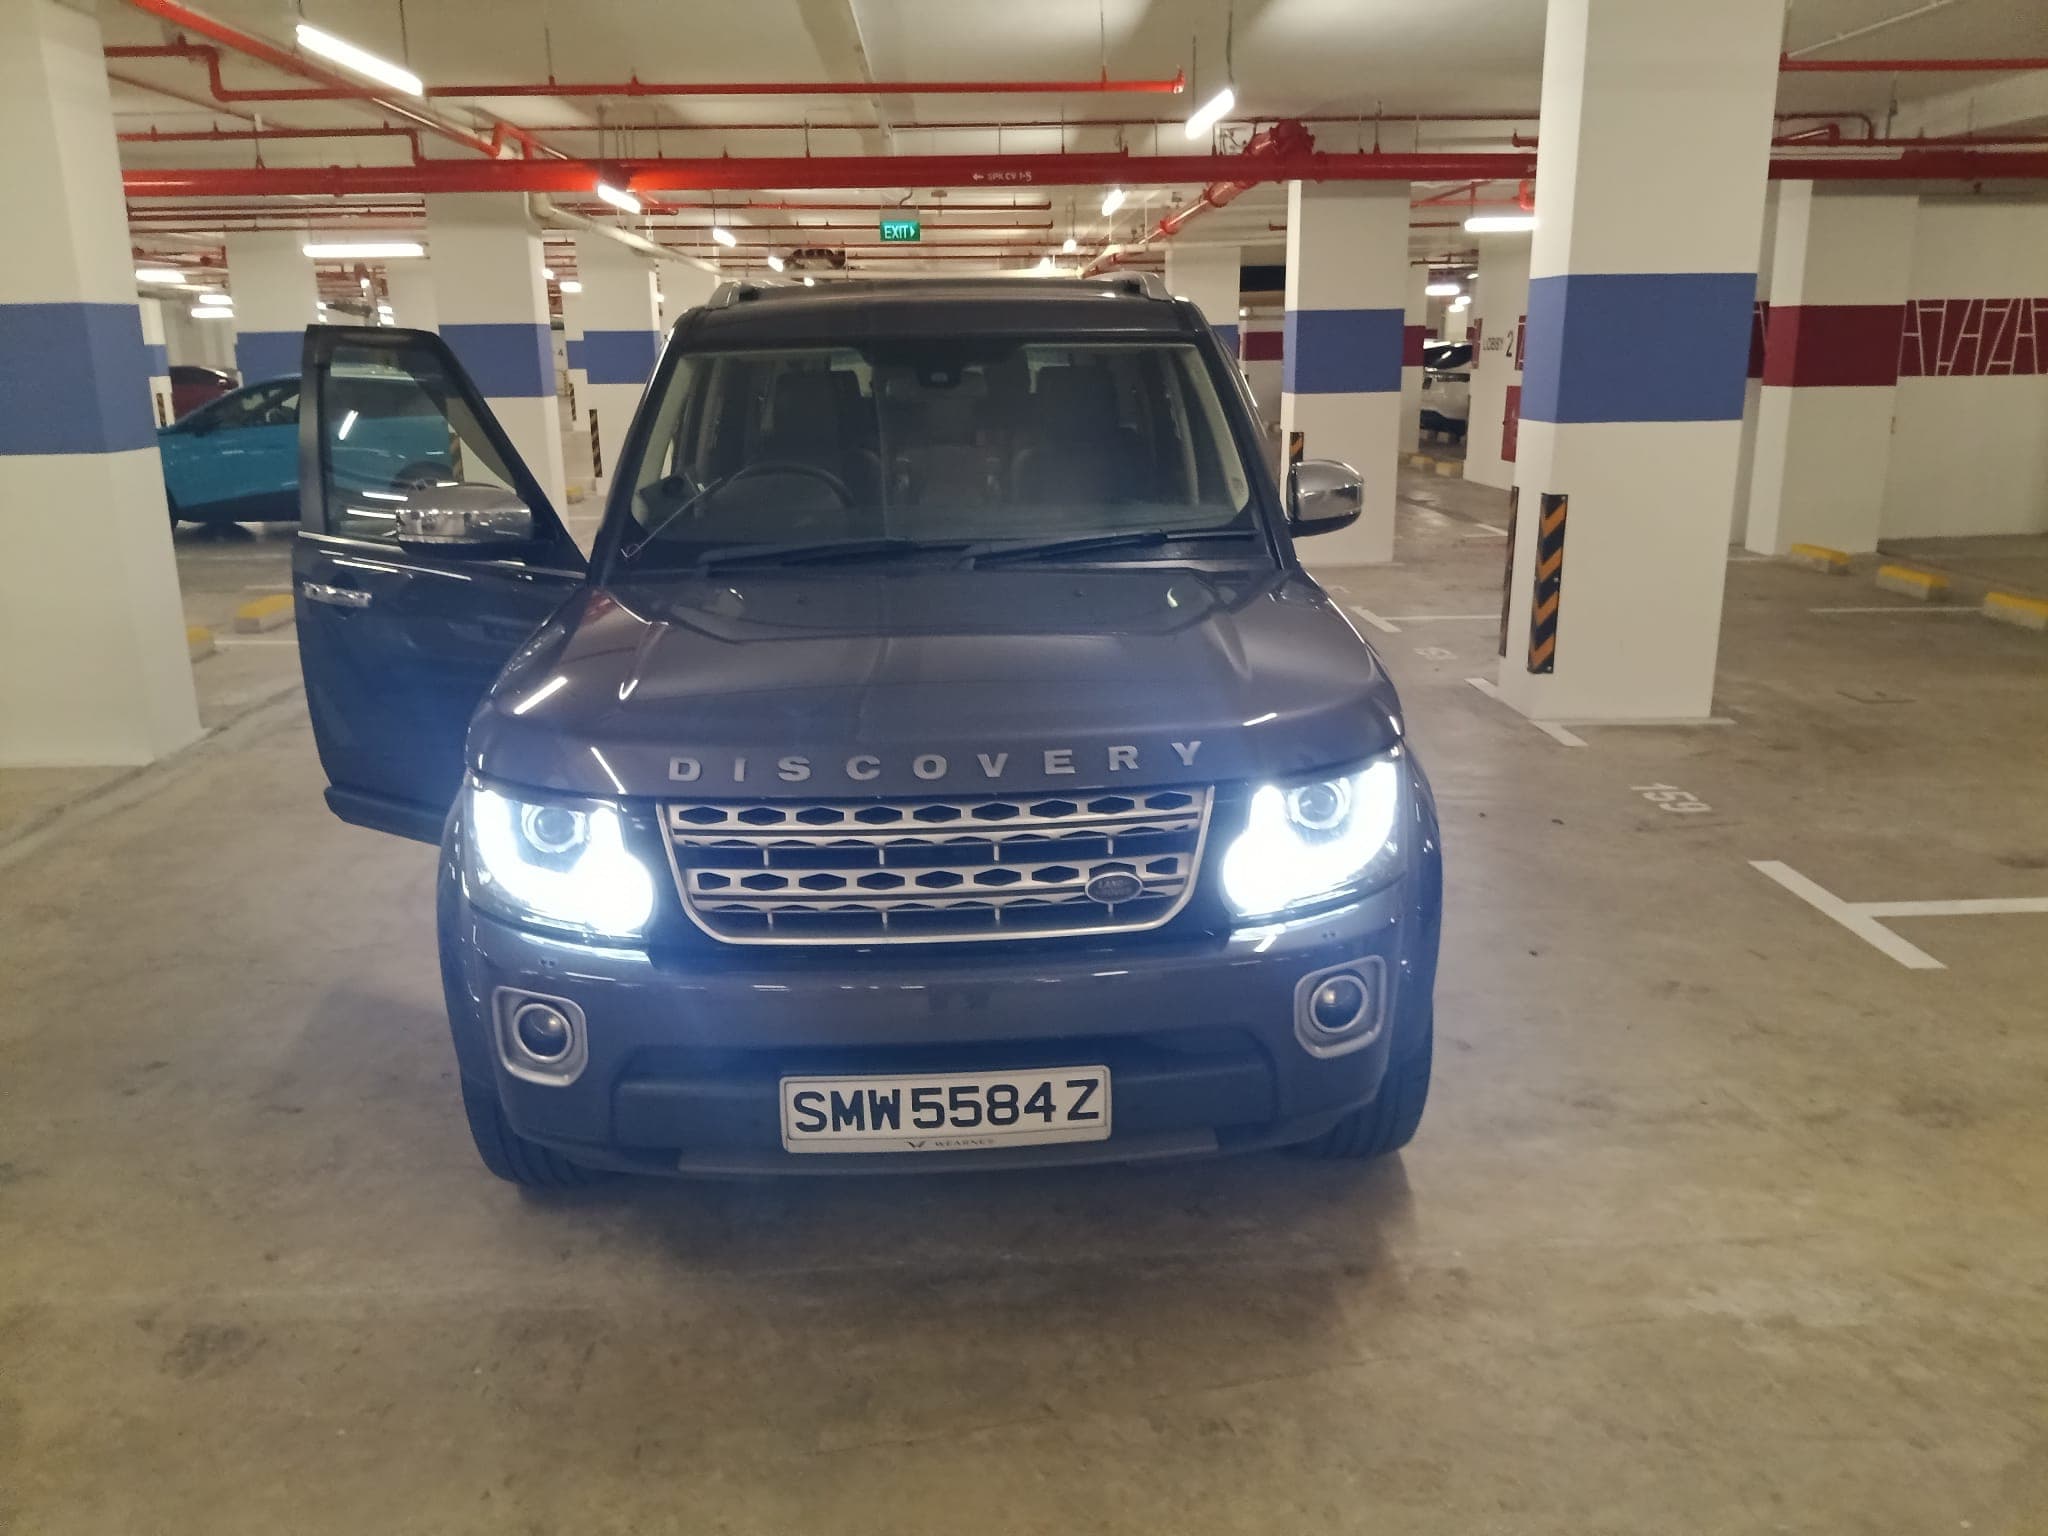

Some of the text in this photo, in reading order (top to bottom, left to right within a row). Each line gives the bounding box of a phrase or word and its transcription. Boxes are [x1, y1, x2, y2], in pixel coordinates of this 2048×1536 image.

[884, 224, 908, 239] EXIT
[668, 740, 1202, 781] DISCOVERY
[1630, 783, 1712, 813] 159
